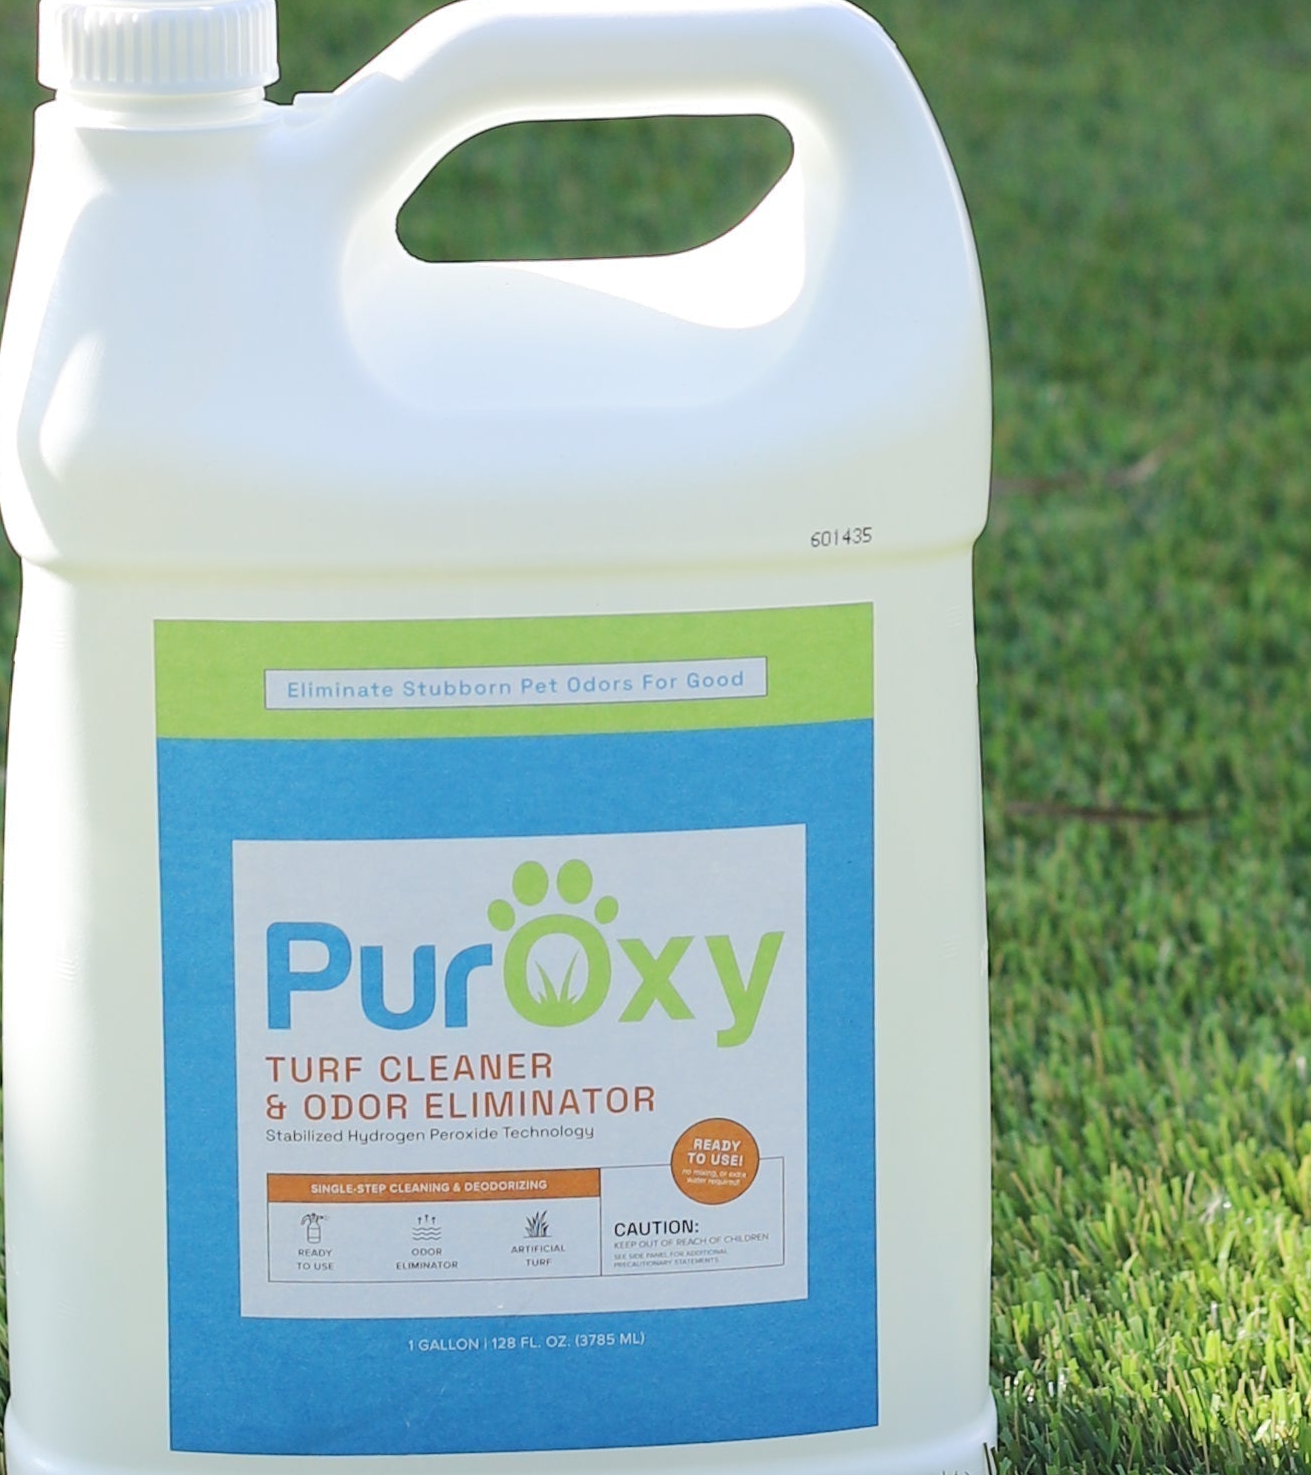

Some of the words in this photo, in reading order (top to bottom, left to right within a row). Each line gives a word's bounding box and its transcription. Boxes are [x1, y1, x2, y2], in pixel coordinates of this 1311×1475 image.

[810, 527, 873, 547] 601435
[287, 681, 394, 698] Eliminate
[402, 680, 511, 696] Stubborn
[521, 678, 557, 694] Pet
[567, 676, 633, 692] Odors
[642, 674, 677, 690] For
[686, 671, 744, 688] Good
[266, 913, 785, 1048] PurOxy
[265, 1057, 362, 1083] TURF
[380, 1052, 553, 1083] CLEANER
[266, 1094, 287, 1120] &
[304, 1093, 408, 1120] ODOR
[425, 1086, 656, 1119] ELIMINATOR
[265, 1129, 343, 1142] Stabilized
[348, 1129, 425, 1145] Hydrogen
[430, 1127, 499, 1141] Peroxide
[503, 1125, 595, 1140] Technology
[693, 1138, 742, 1152] READY
[687, 1152, 707, 1165] TO
[710, 1153, 744, 1167] USE!
[310, 1183, 387, 1194] SINGLE-STEP
[389, 1182, 450, 1193] CLEANING
[453, 1182, 461, 1192] &
[464, 1180, 548, 1192] DEODORIZING
[614, 1219, 700, 1237] CAUTION:
[614, 1240, 637, 1249] KEEP
[639, 1239, 658, 1248] OUT
[661, 1237, 674, 1247] OF
[677, 1236, 707, 1246] REACH
[709, 1235, 722, 1245] OF
[724, 1232, 770, 1243] CHILDREN
[298, 1249, 333, 1257] READY
[411, 1248, 443, 1257] ODOR
[511, 1244, 566, 1254] ARTIFICIAL
[297, 1262, 311, 1271] TO
[314, 1262, 335, 1271] USE
[396, 1260, 459, 1270] ELIMINATOR
[525, 1258, 553, 1268] TURF
[408, 1339, 414, 1351] 1
[418, 1338, 479, 1351] GALLON
[491, 1337, 516, 1350] 128
[520, 1336, 541, 1348] FL.
[545, 1335, 571, 1348] OZ.
[574, 1333, 615, 1347] (3785
[620, 1331, 645, 1345] ML)
